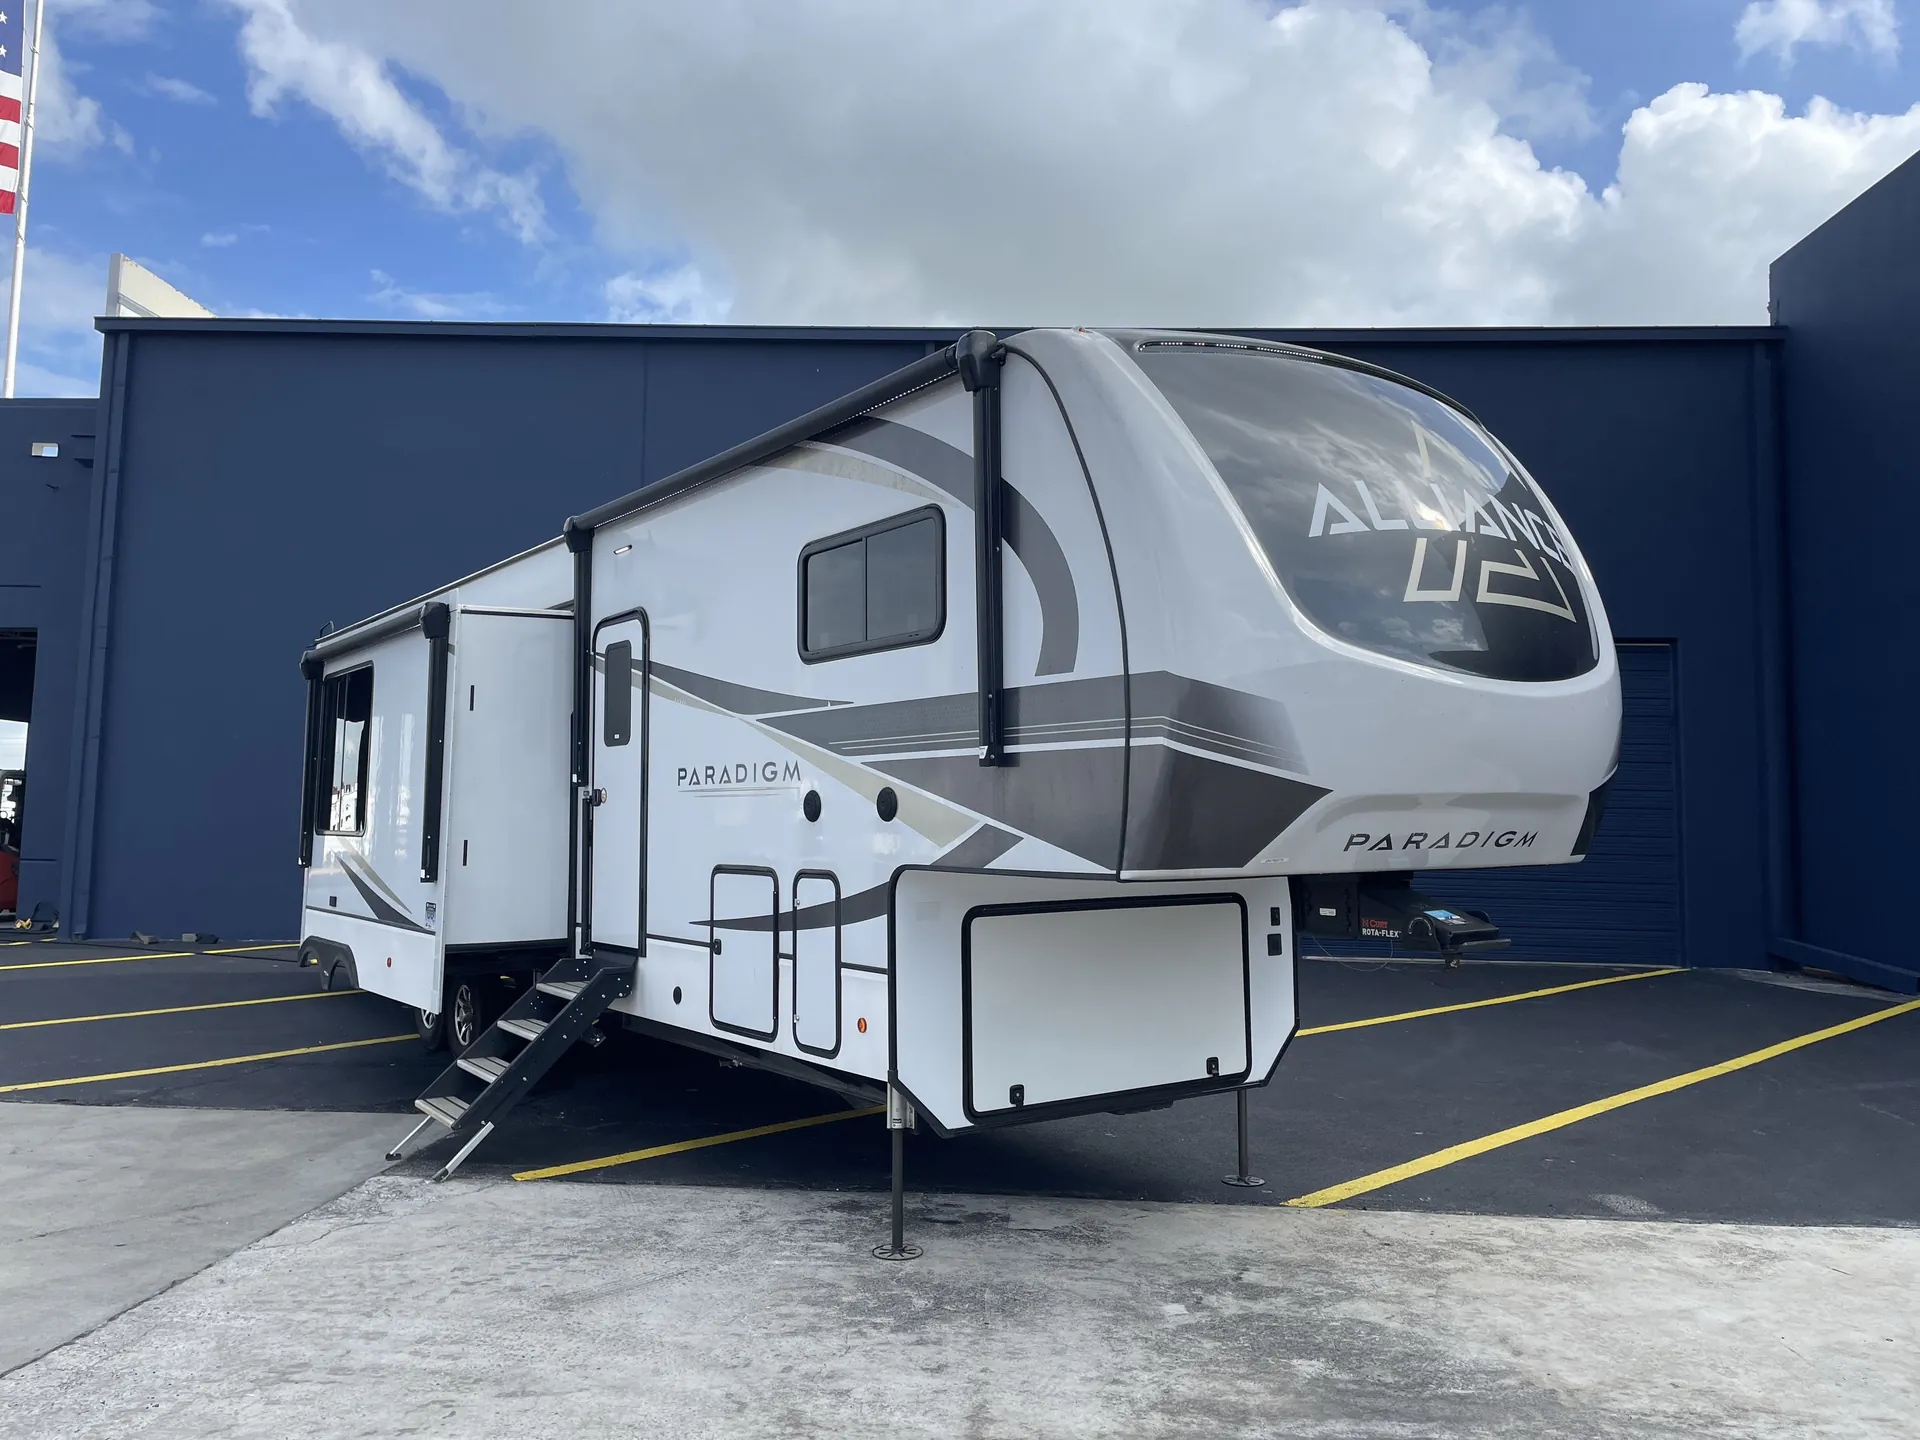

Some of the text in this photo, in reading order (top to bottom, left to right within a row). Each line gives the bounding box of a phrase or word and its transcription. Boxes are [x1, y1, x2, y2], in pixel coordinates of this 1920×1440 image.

[1308, 480, 1577, 576] ALLIANCE
[677, 760, 801, 786] PARADIGM
[1343, 830, 1539, 852] PARADIGM
